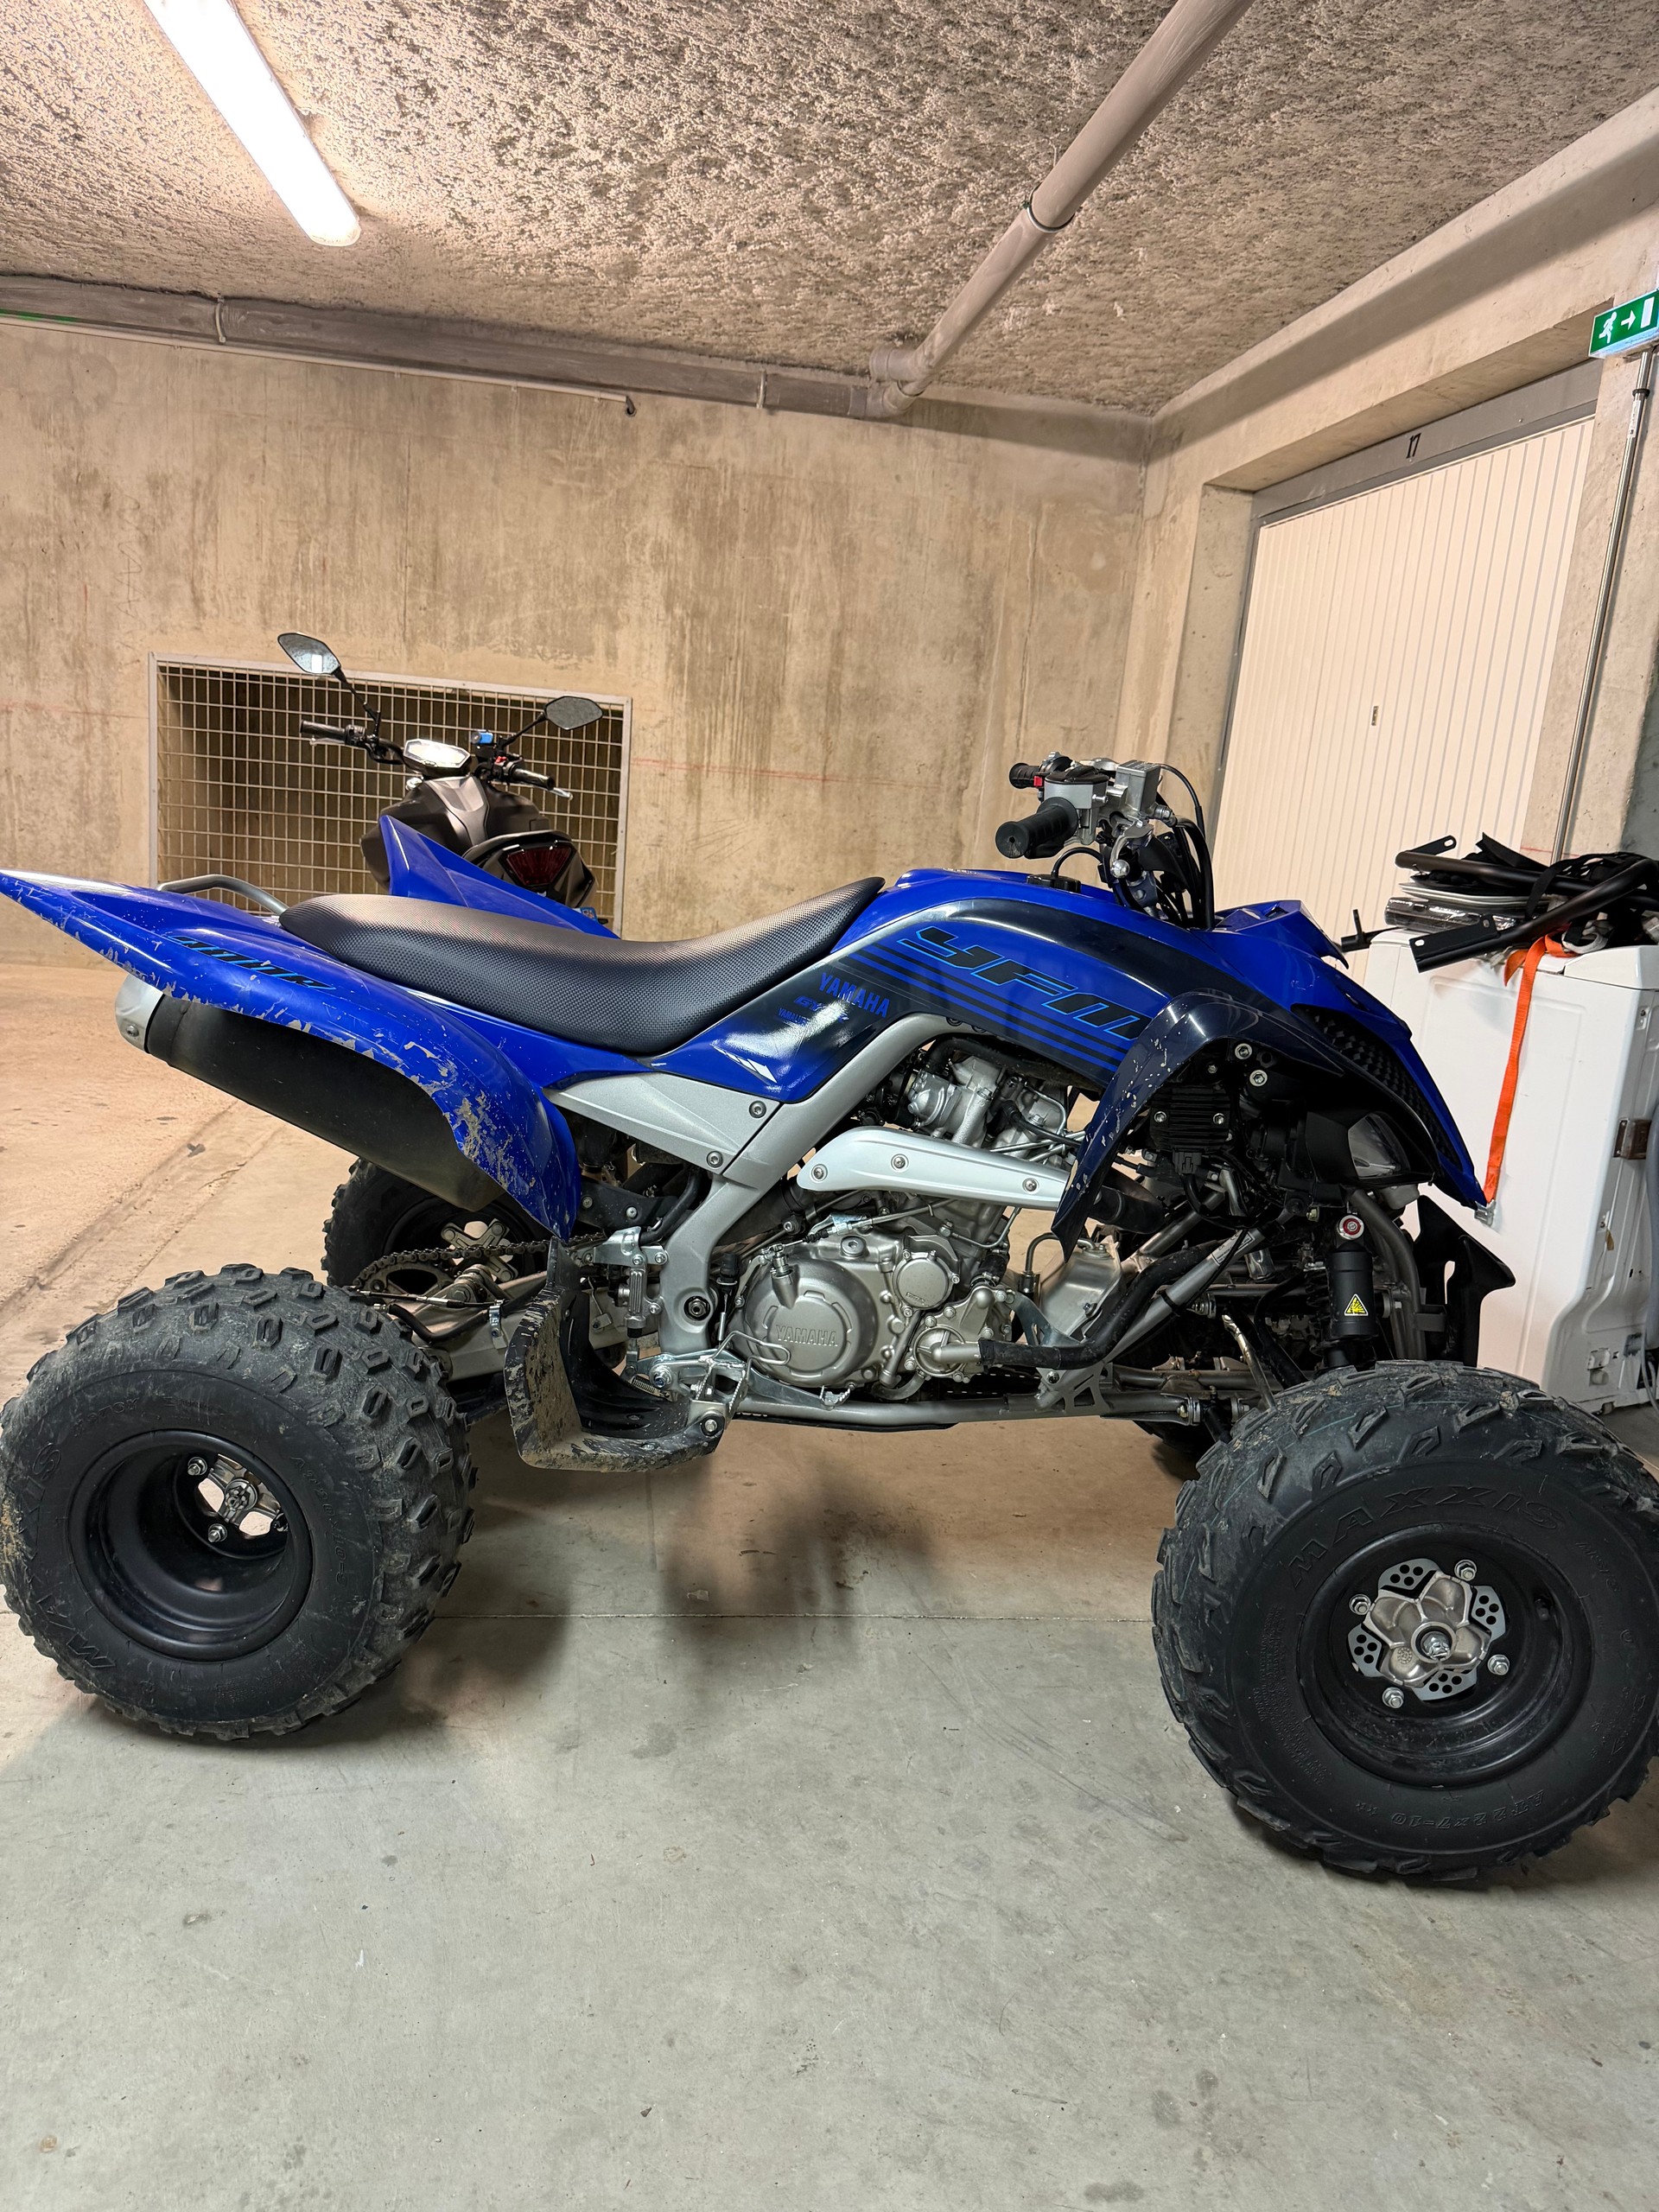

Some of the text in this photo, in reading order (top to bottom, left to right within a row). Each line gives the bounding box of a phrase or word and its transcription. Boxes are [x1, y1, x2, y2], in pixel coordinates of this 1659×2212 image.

[1406, 433, 1422, 459] 17
[818, 972, 890, 1018] YAMAHA
[897, 925, 1152, 1041] YFM
[776, 1325, 839, 1347] YAMAHA
[1287, 1485, 1567, 1588] MAXXIS
